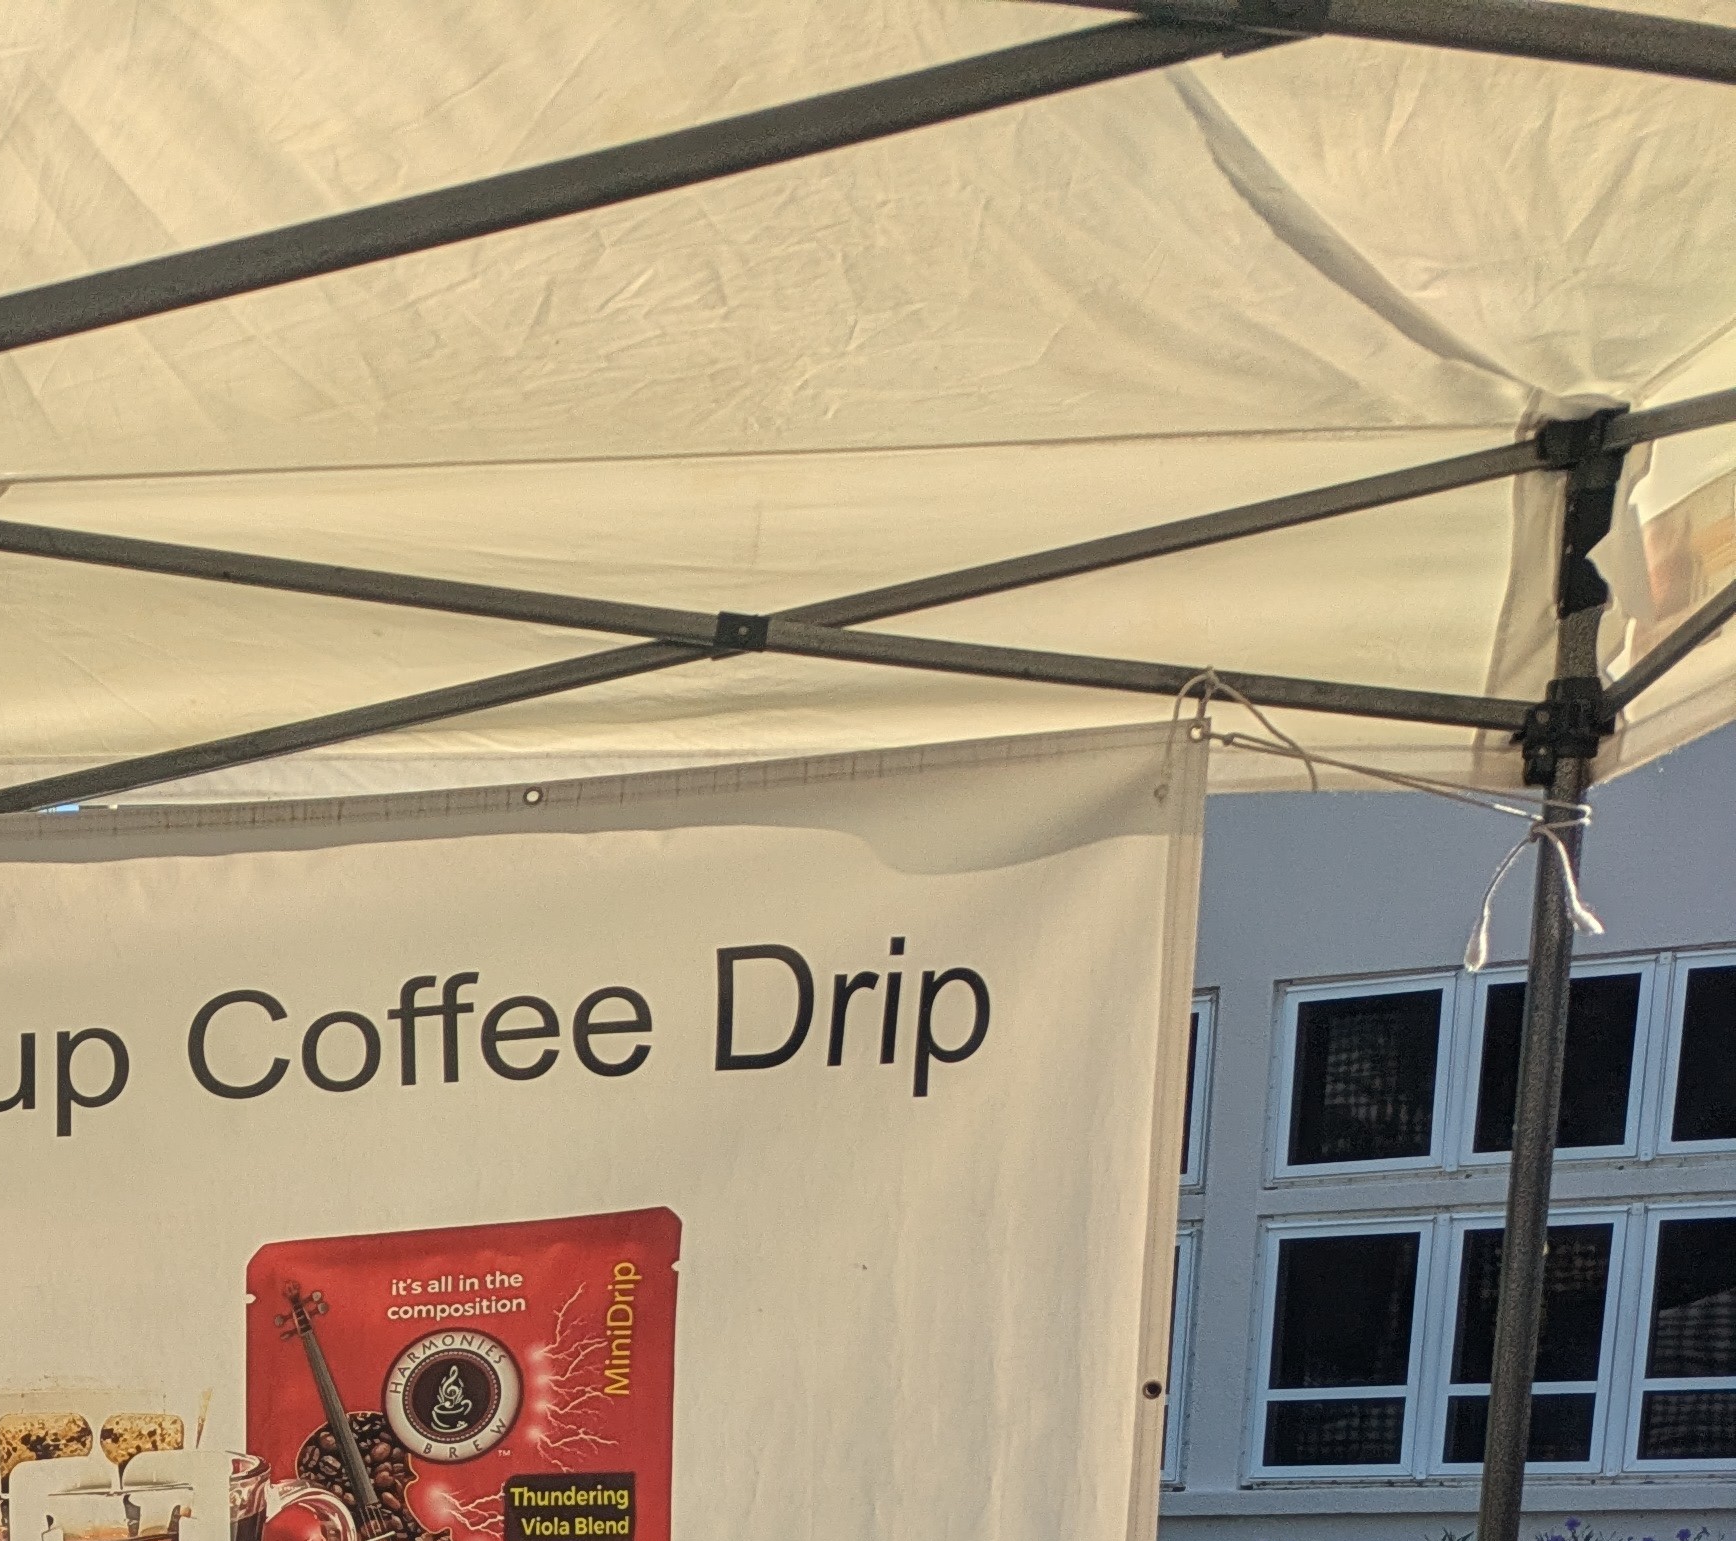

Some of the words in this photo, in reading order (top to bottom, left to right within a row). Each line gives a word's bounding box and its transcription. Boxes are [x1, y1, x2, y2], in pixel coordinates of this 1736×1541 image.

[186, 971, 653, 1099] Coffee
[714, 936, 992, 1097] Drip
[391, 1278, 422, 1295] it's
[428, 1276, 452, 1293] all
[459, 1275, 479, 1292] in
[485, 1271, 523, 1289] the
[386, 1296, 526, 1320] composition
[604, 1261, 642, 1396] MiniDrip
[390, 1334, 506, 1395] HARMONIES
[423, 1419, 507, 1459] BREW
[510, 1486, 629, 1511] Thundering
[522, 1516, 570, 1537] Viola
[575, 1515, 629, 1536] Blend
